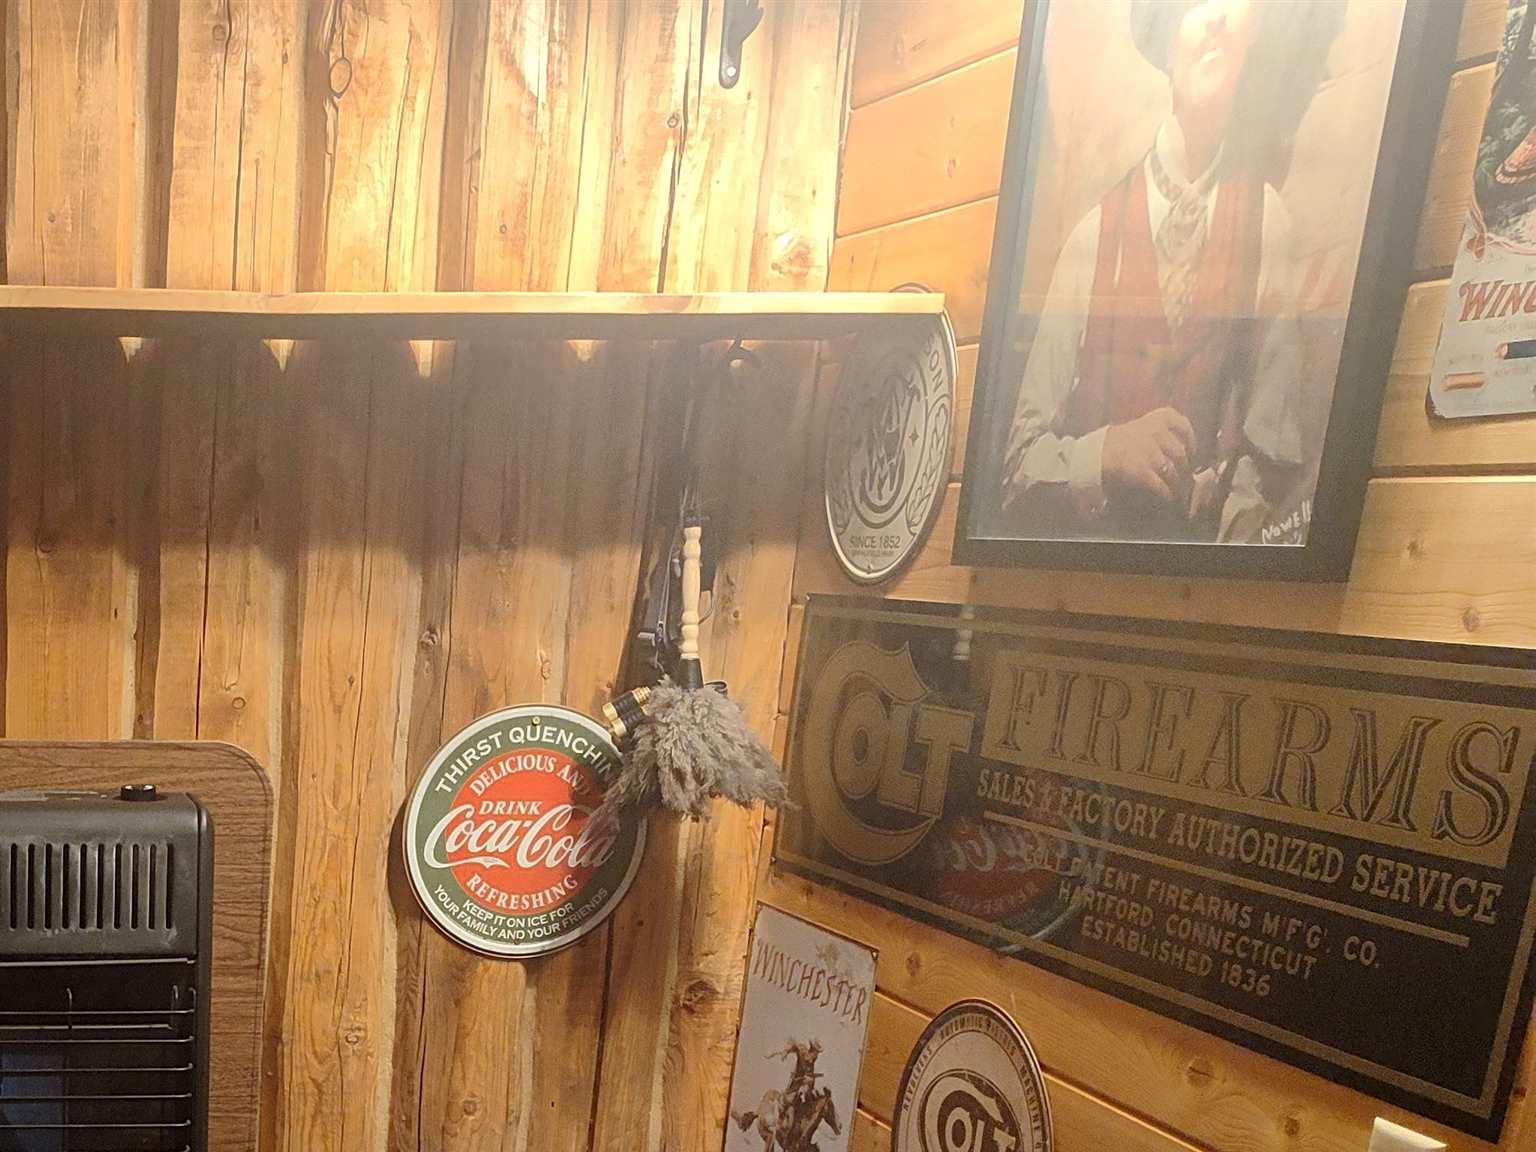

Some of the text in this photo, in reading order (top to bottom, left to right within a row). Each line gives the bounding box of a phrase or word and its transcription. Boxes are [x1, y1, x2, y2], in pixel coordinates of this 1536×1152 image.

[879, 535, 901, 548] 1852
[434, 724, 616, 793] THIRST QUENCHIN
[469, 754, 557, 796] DELICIOUS
[997, 664, 1521, 848] FIREARMS
[423, 803, 616, 869] Coca-Cola
[479, 800, 543, 815] DRINK
[977, 768, 1037, 808] SALES
[1059, 786, 1167, 838] FACTORY
[1167, 811, 1344, 884] AUTHORIZED
[1351, 853, 1504, 925] SERVICE
[434, 884, 609, 940] YOUR FAMILY AND YOUR FRIENDS
[463, 899, 574, 928] KEEP IT ON ICE FOR
[466, 873, 579, 911] REFRESHING
[1147, 877, 1253, 929] FIREARMS
[1080, 915, 1272, 998] ESTABLISHED 1836
[1166, 913, 1317, 979] CONNECTICUT
[751, 937, 867, 1025] WINCHESTER
